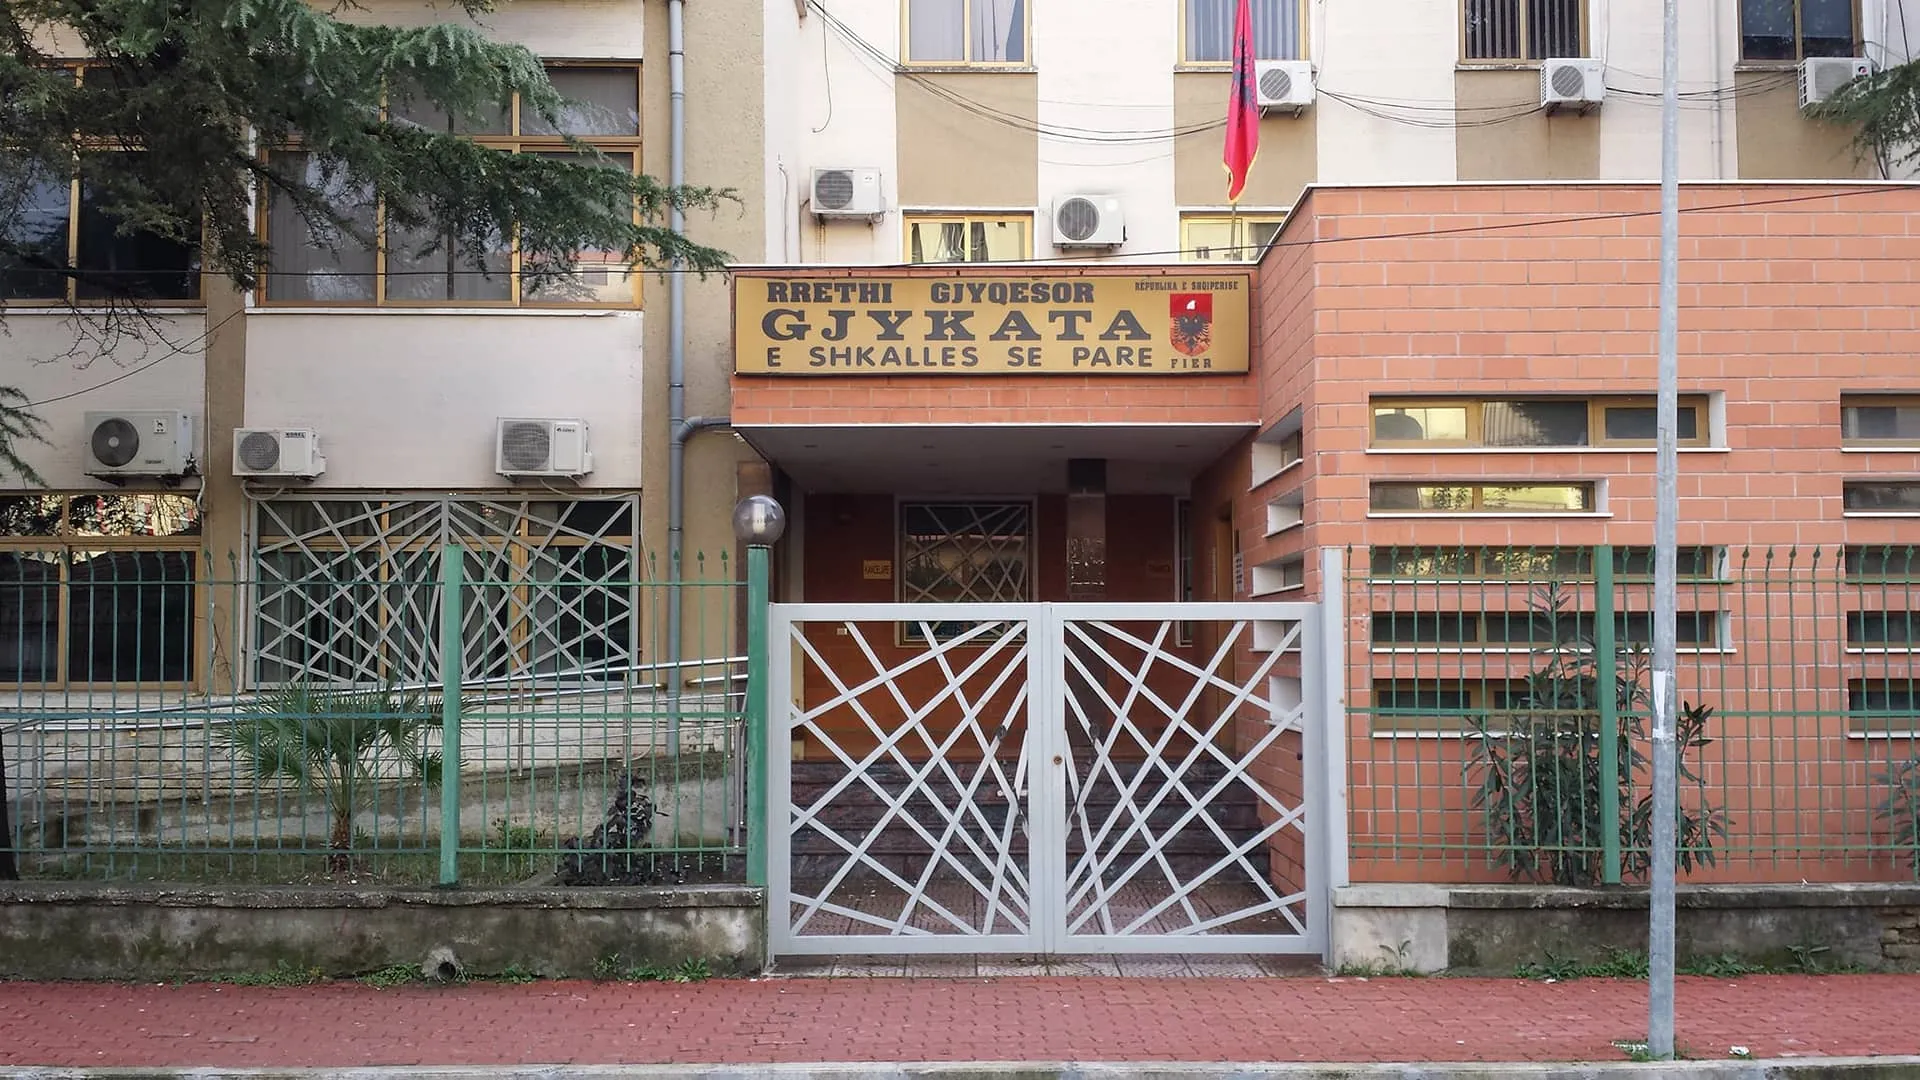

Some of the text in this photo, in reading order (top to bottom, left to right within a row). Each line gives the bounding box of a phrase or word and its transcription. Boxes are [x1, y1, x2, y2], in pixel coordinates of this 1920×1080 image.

[767, 281, 1095, 306] RRETHI GJYQESOR
[761, 308, 1152, 341] GJYKATA
[767, 346, 1153, 368] E SHKALLES SE PARE
[1171, 358, 1212, 369] FIER
